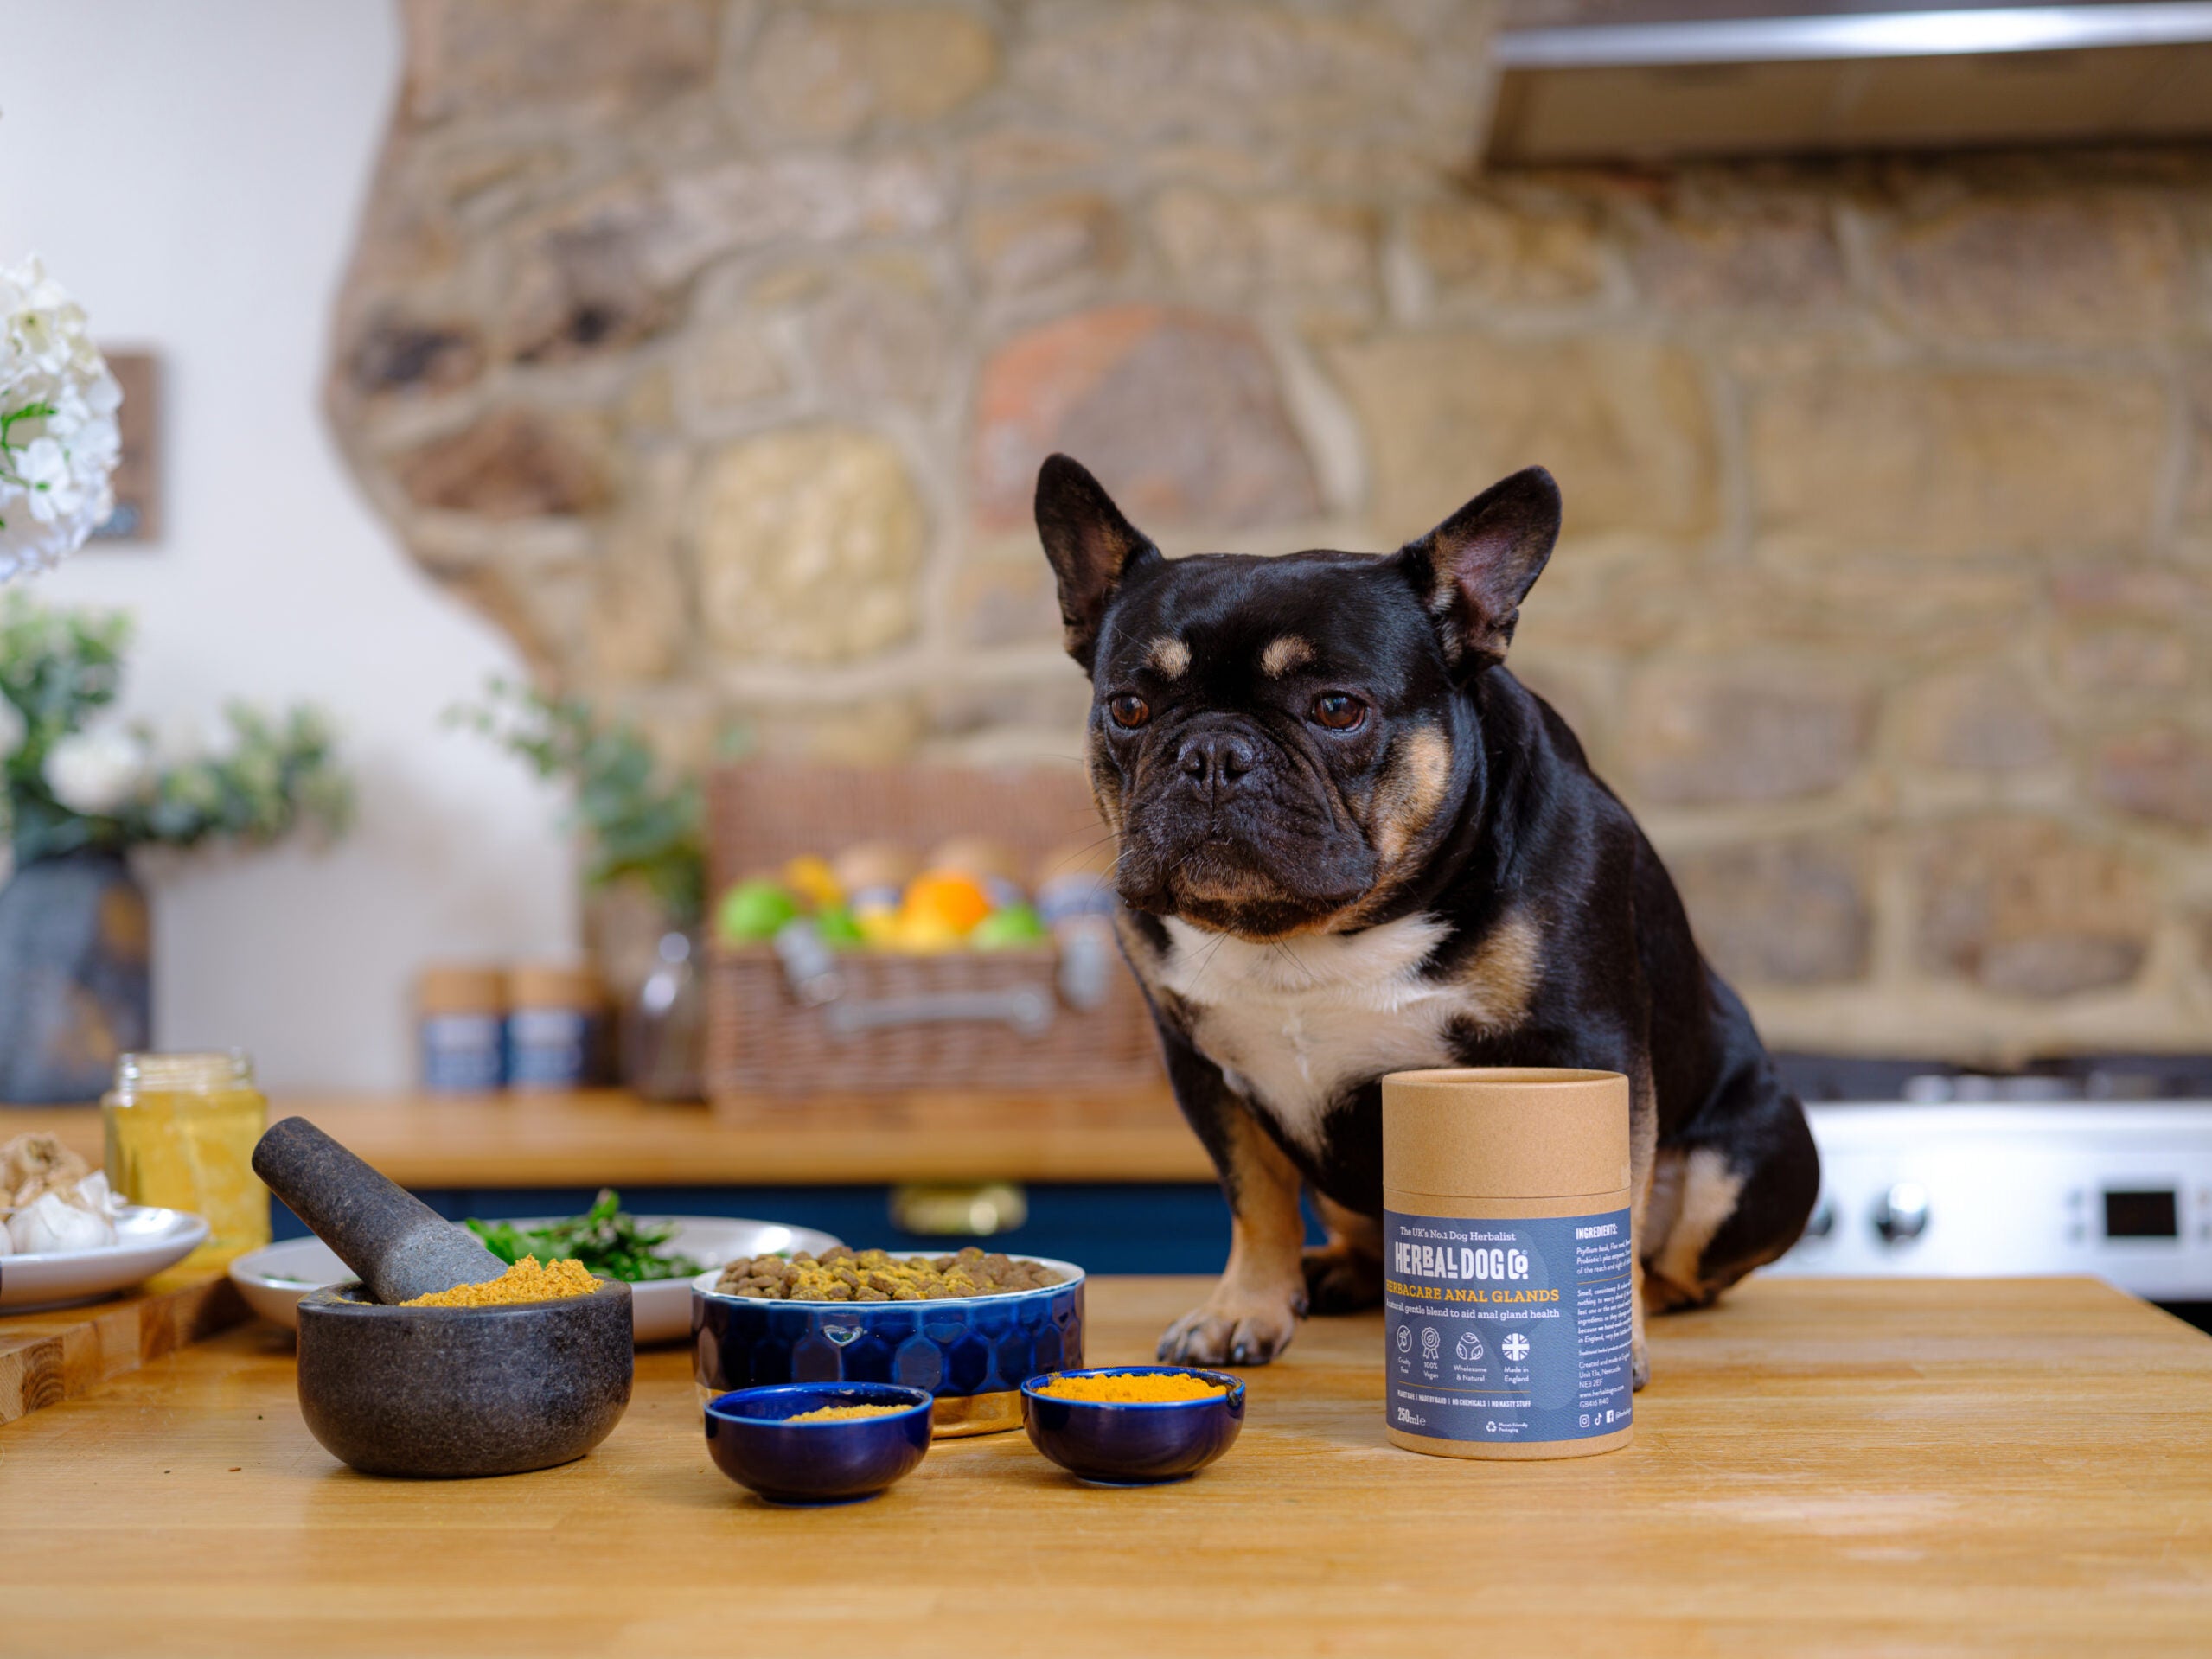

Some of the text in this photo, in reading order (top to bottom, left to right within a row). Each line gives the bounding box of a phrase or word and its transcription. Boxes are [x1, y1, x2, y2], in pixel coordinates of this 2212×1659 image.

[1400, 1226, 1517, 1242] The UK's No.1 Dog Herbalist
[1576, 1222, 1617, 1240] INGREDIENTS:
[1395, 1241, 1459, 1279] HERBAL
[1461, 1247, 1505, 1280] DOG
[1444, 1288, 1488, 1303] ANAL
[1492, 1289, 1560, 1303] GLANDS
[1404, 1305, 1425, 1315] gentle
[1426, 1306, 1448, 1318] blend
[1449, 1309, 1460, 1318] to
[1461, 1310, 1476, 1318] aid
[1477, 1310, 1499, 1319] anal
[1499, 1310, 1528, 1321] gland
[1530, 1308, 1560, 1318] health
[1424, 1362, 1438, 1370] 100%
[1454, 1364, 1487, 1373] Wholesome
[1423, 1370, 1439, 1381] Vegan
[1462, 1373, 1485, 1381] Natural
[1504, 1375, 1530, 1385] England
